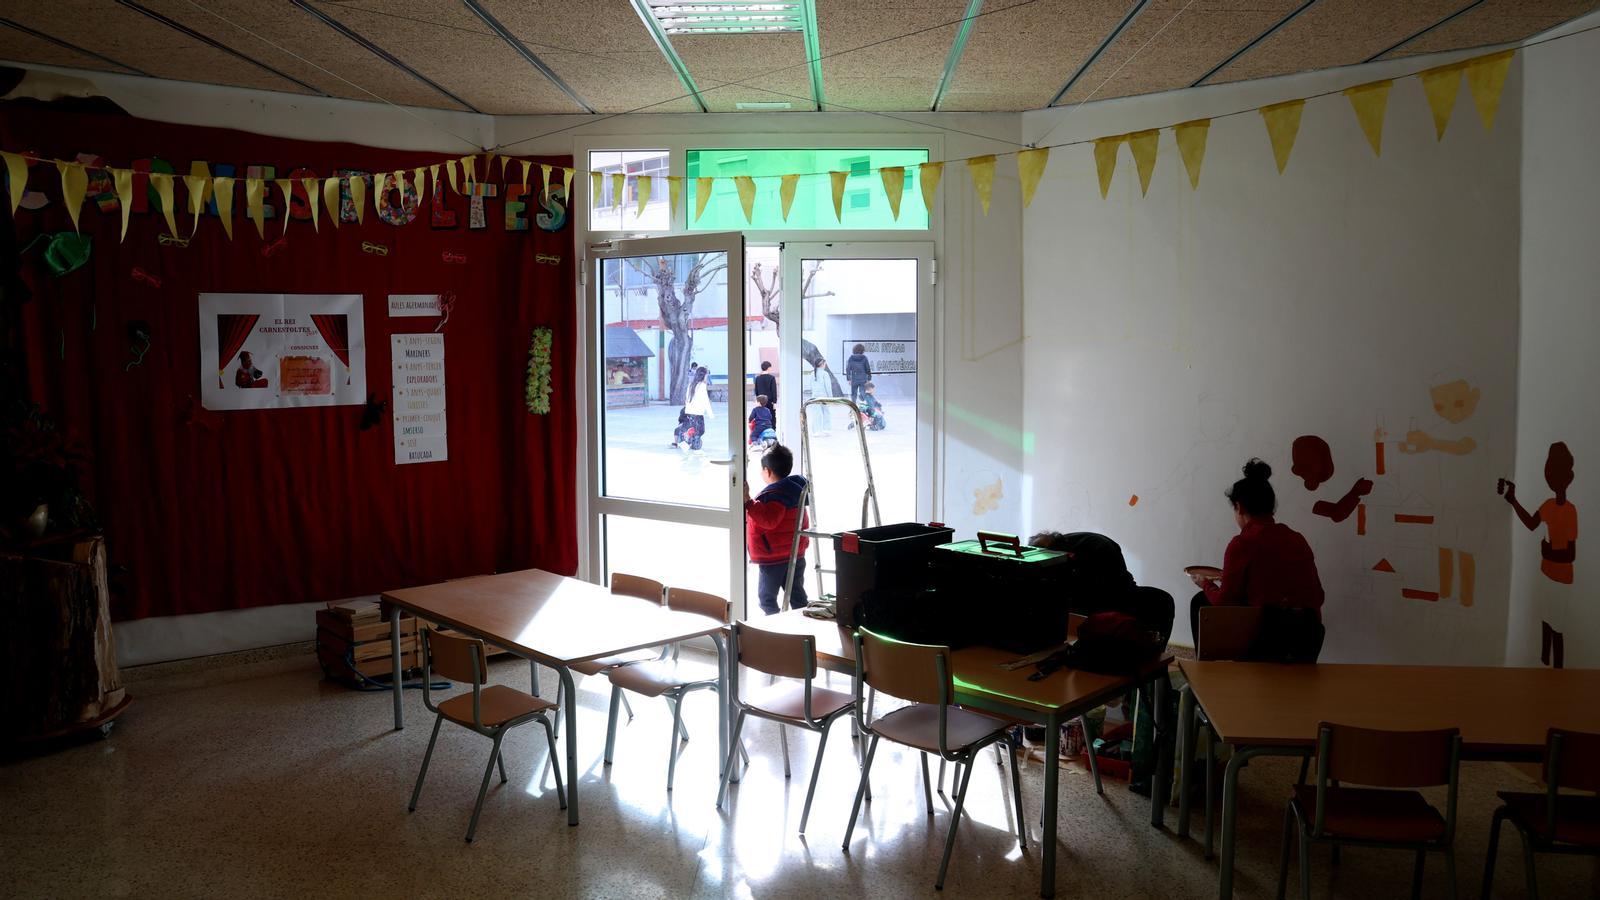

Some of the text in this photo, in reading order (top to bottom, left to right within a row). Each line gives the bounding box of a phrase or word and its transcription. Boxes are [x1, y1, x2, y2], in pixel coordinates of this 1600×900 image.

[406, 301, 440, 310] AGERMANADE
[406, 375, 438, 384] EXPLORADORS
[408, 450, 433, 460] BATUCADA
